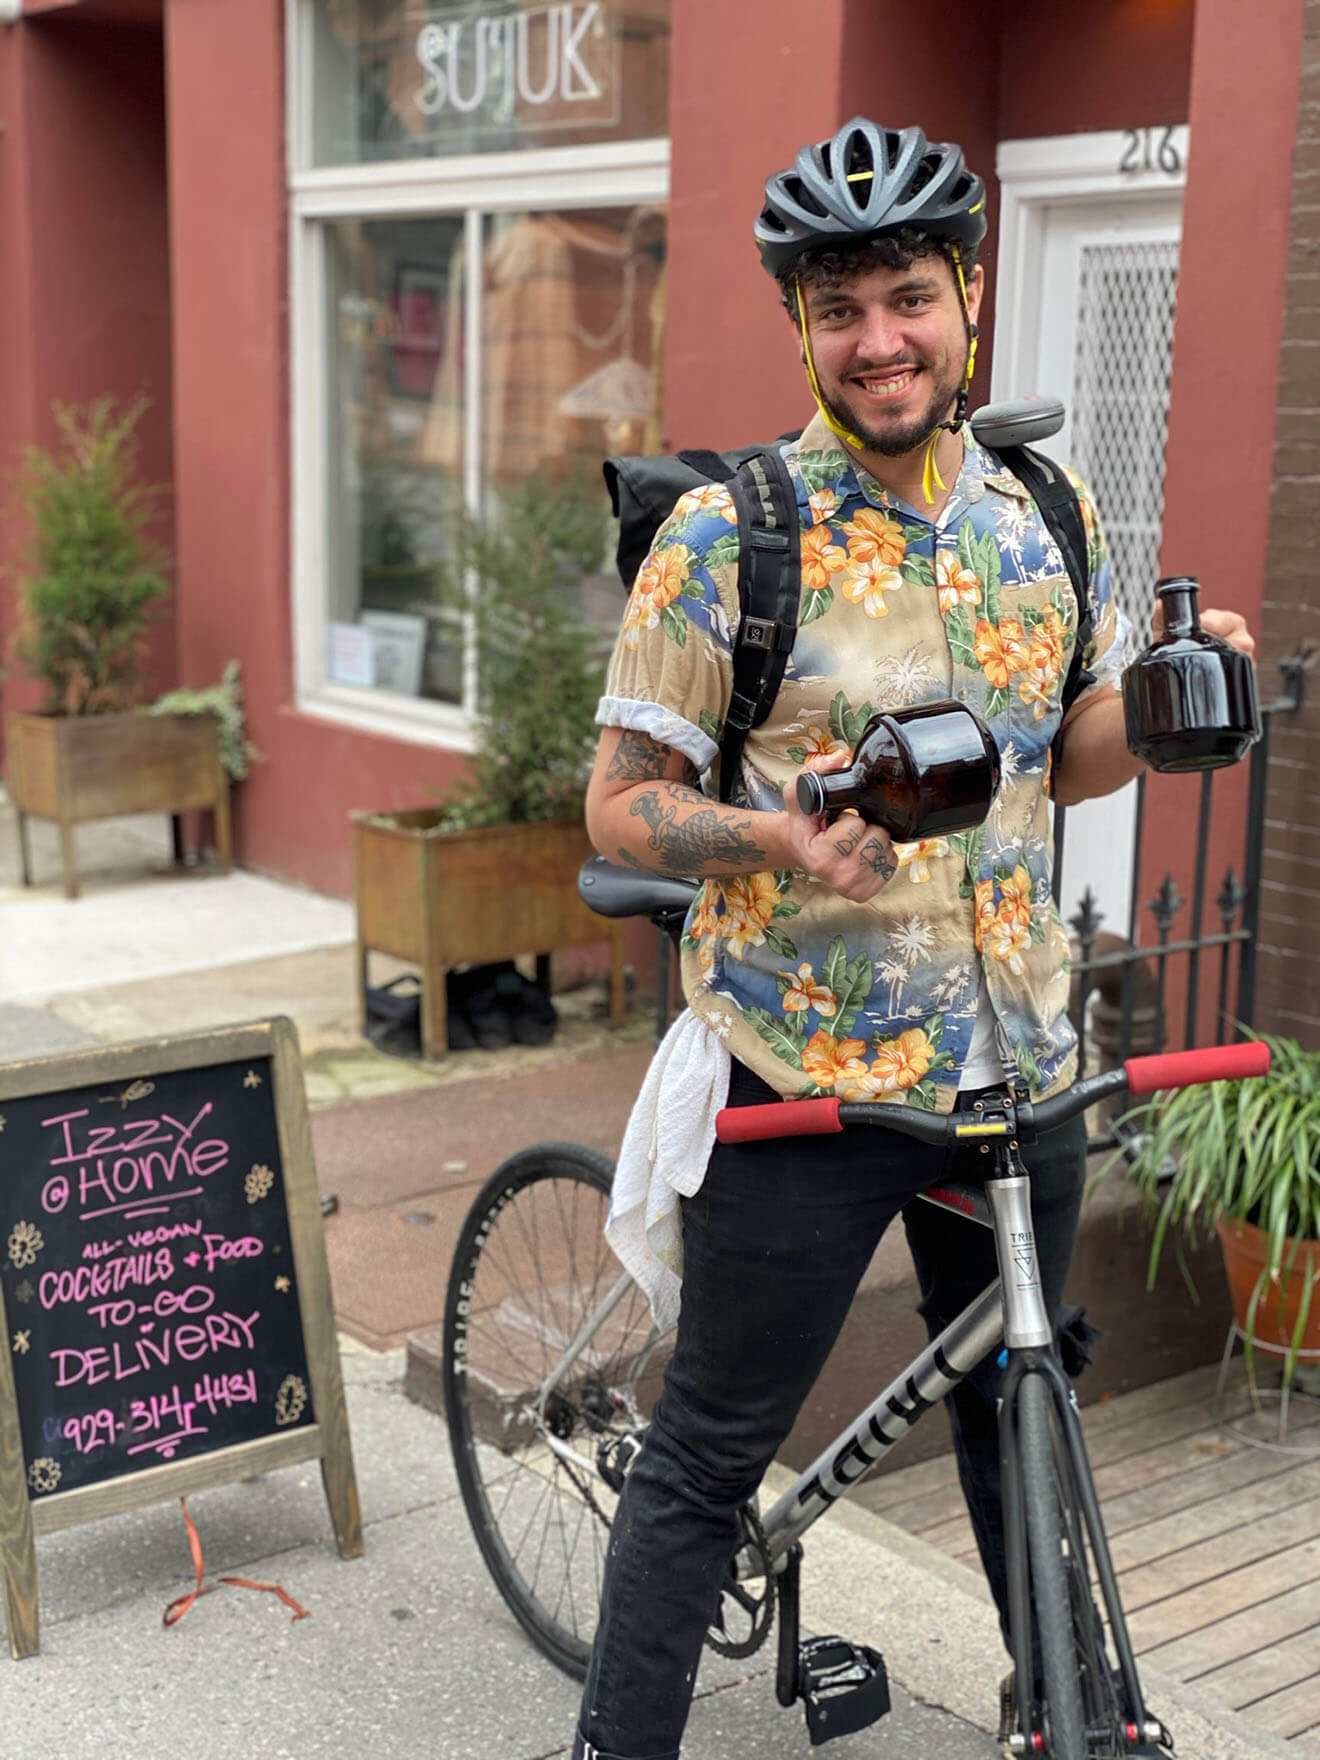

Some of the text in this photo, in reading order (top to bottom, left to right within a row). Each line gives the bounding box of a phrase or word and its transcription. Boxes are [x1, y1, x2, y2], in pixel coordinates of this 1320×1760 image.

[413, 2, 602, 124] SUJUK
[1117, 125, 1180, 175] 216
[41, 1101, 214, 1166] IZZY
[39, 1246, 176, 1310] COCKTAILS
[202, 1233, 265, 1273] FOOD
[87, 1285, 216, 1329] TO-GO
